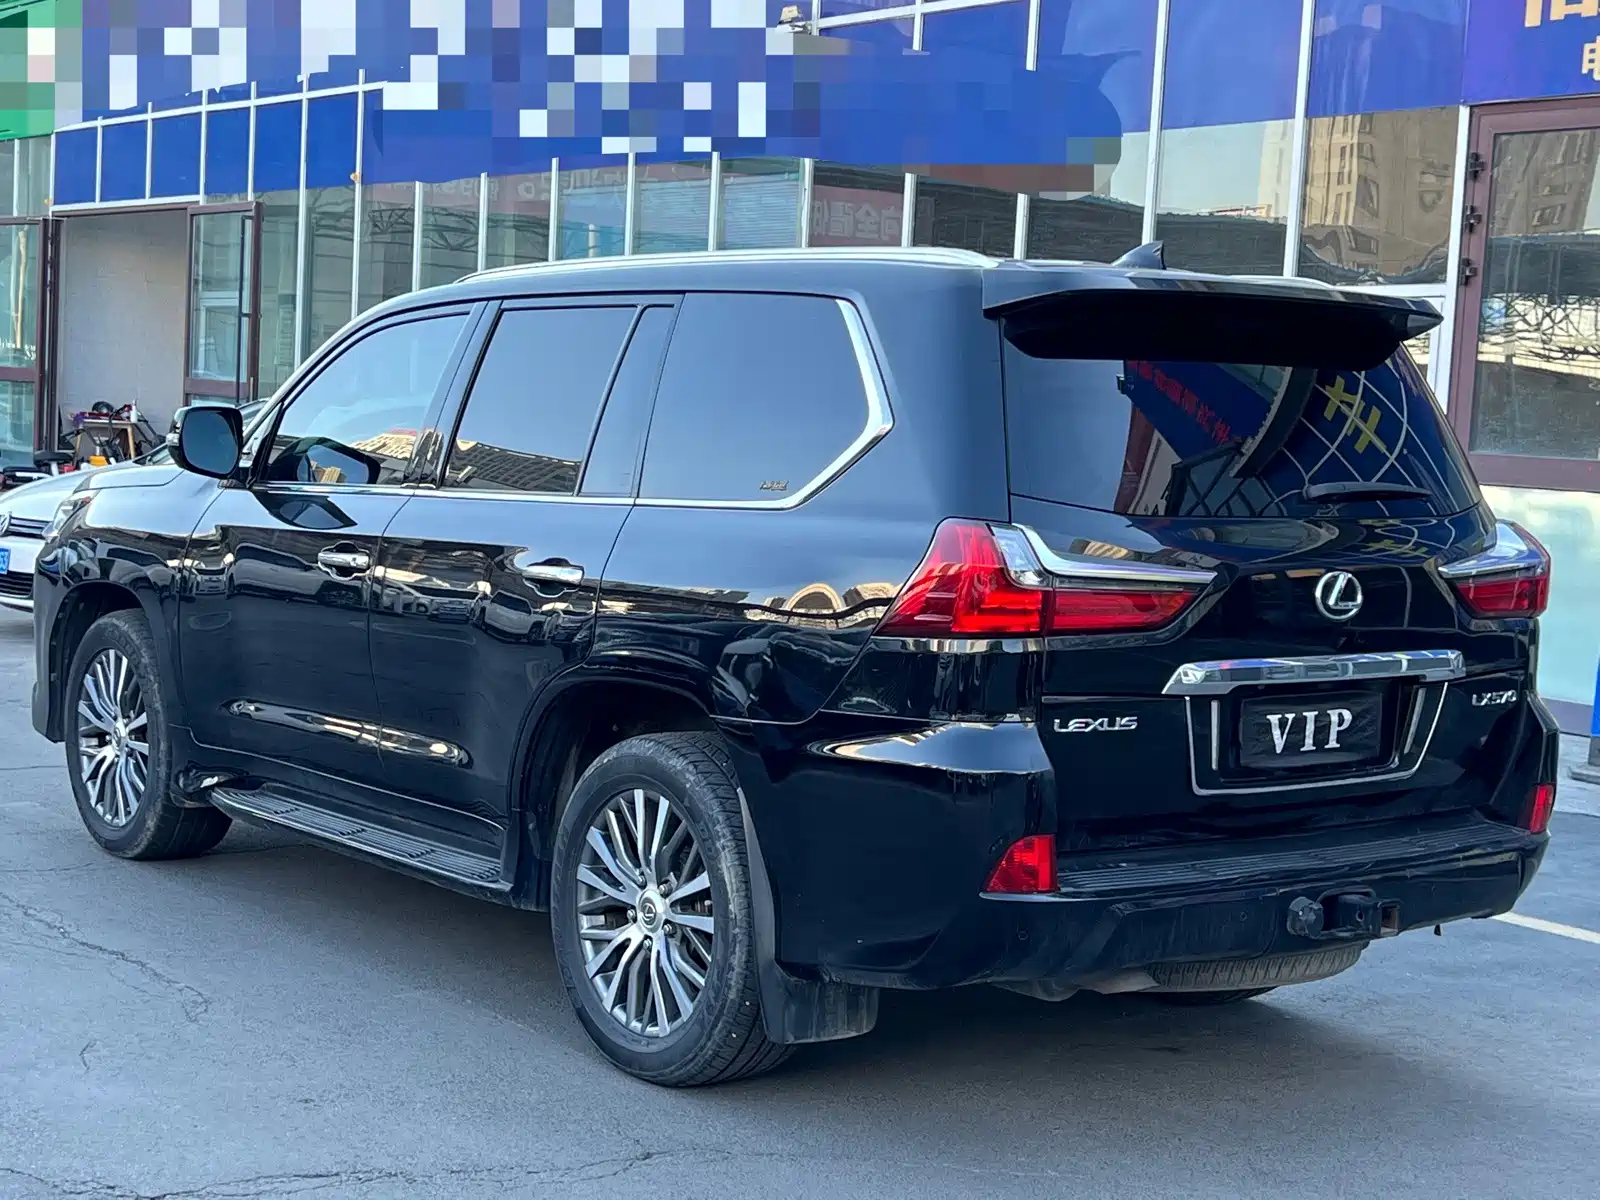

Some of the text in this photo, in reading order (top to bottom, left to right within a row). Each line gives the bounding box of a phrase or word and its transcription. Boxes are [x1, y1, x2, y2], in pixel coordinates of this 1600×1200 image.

[1471, 689, 1517, 706] LX570
[1053, 716, 1138, 732] LEXUS
[1266, 708, 1353, 754] VIP
